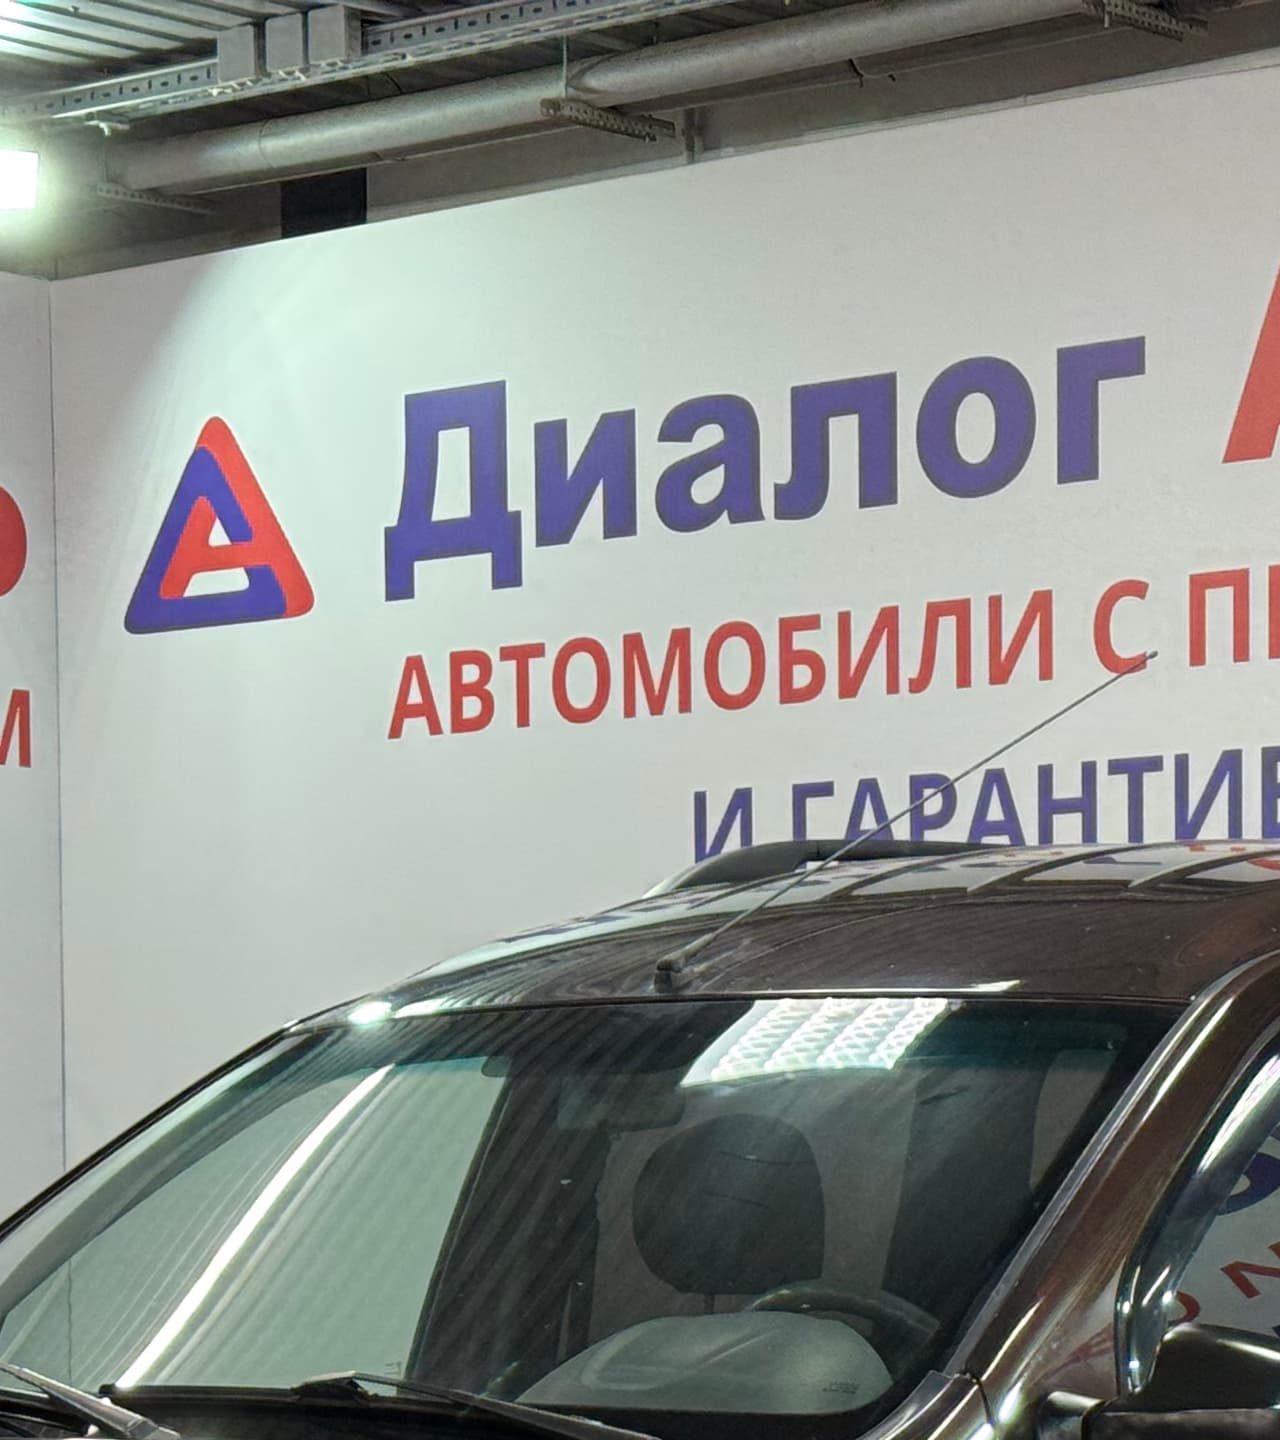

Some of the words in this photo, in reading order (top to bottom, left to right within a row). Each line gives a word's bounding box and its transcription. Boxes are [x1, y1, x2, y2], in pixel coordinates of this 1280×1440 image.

[383, 338, 1147, 605] Диалог
[388, 590, 1055, 741] АВТОМОБИЛИ
[1093, 579, 1149, 676] С
[693, 785, 754, 865] И
